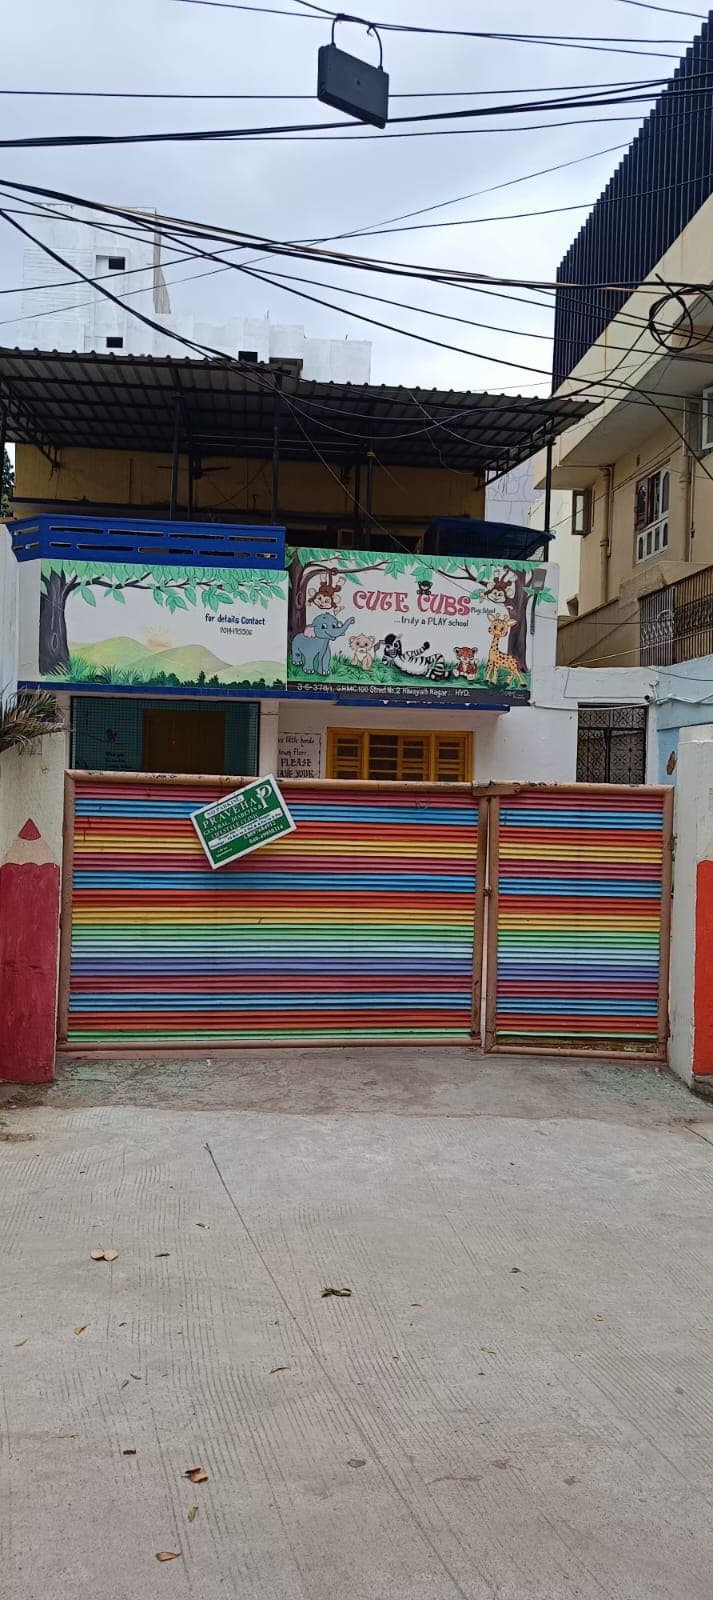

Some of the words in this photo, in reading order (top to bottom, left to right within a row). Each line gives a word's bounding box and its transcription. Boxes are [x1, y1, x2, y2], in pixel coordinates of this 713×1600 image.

[352, 590, 410, 612] CUTE
[417, 592, 470, 616] CUBS
[205, 613, 214, 622] for
[217, 614, 240, 624] details
[241, 616, 265, 625] Contact
[428, 616, 447, 626] PLAY
[448, 618, 468, 627] school
[280, 758, 312, 767] PLEASE
[203, 798, 256, 828] PRAVEHA
